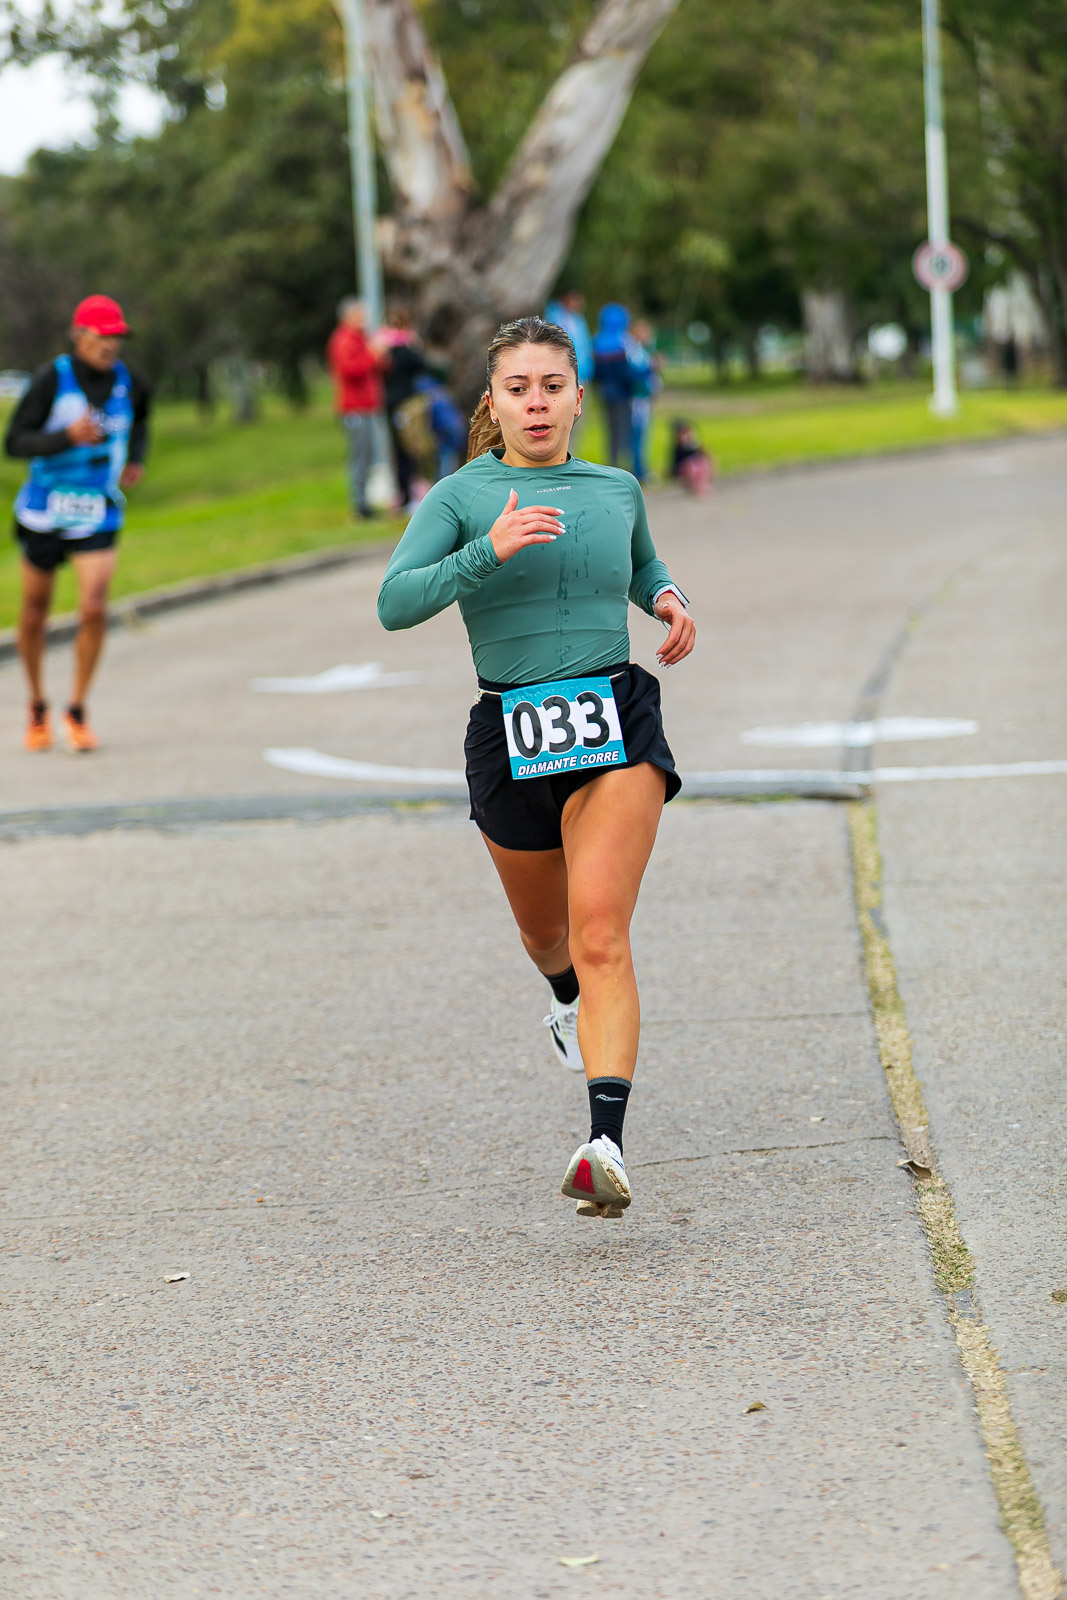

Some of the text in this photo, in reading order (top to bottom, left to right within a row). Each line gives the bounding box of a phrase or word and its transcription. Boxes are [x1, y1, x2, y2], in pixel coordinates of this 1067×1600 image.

[511, 691, 610, 760] 033
[517, 751, 619, 776] DIAMANTE CORRE
